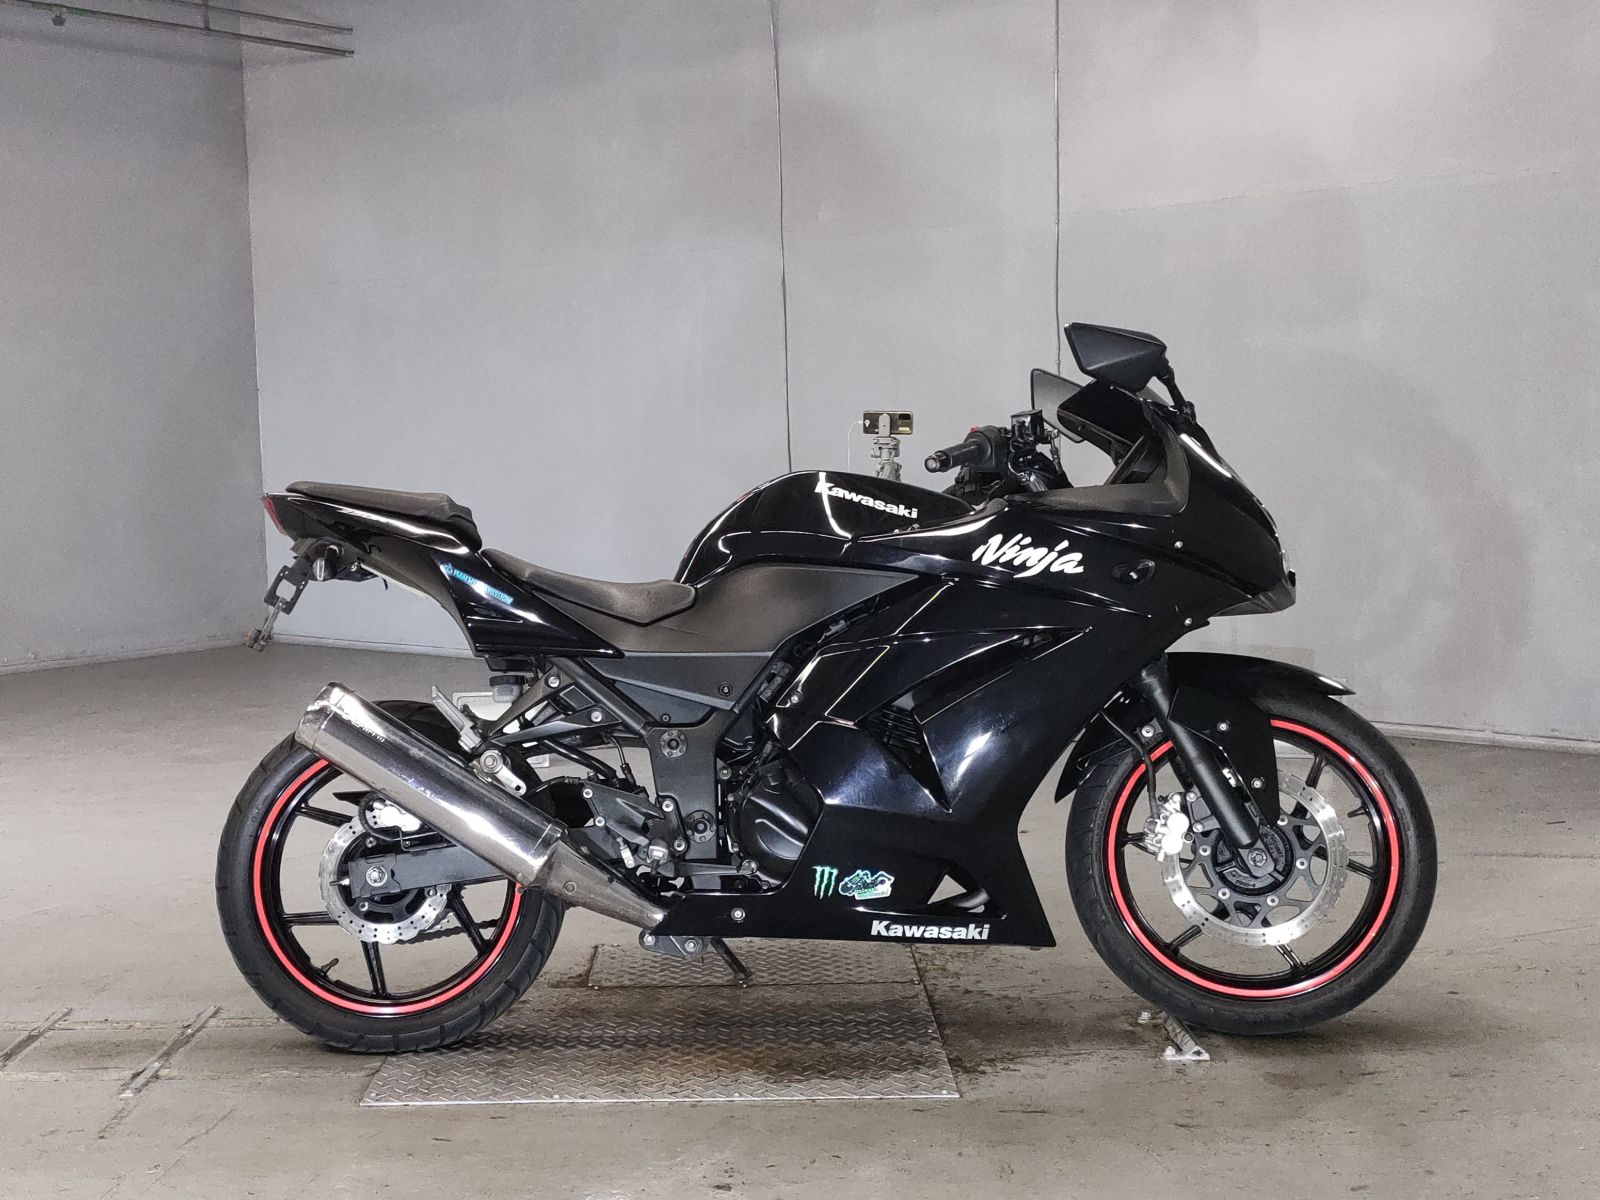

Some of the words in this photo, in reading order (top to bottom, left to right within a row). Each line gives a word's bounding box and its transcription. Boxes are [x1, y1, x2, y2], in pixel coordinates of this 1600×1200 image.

[814, 481, 918, 518] Kawasaki
[972, 533, 1084, 578] Ninja
[871, 920, 990, 939] Kawasaki
